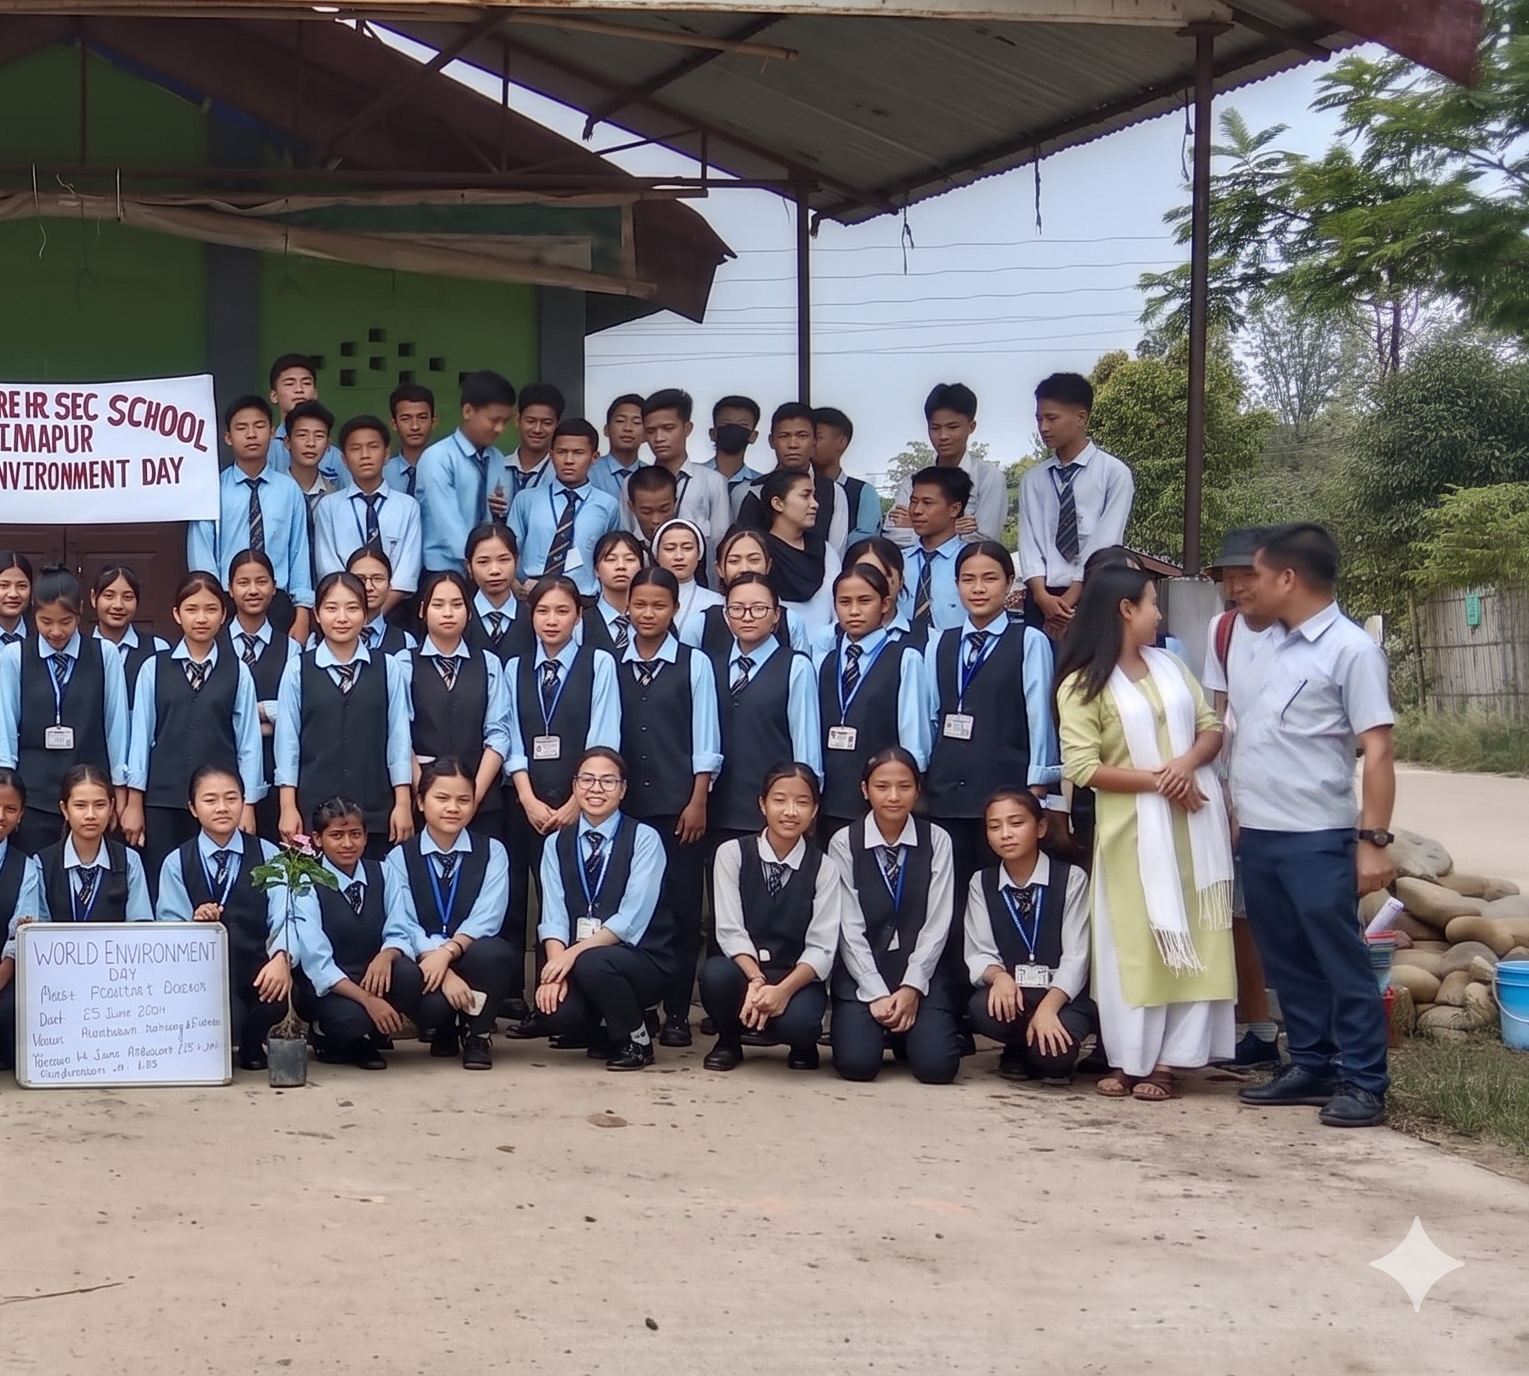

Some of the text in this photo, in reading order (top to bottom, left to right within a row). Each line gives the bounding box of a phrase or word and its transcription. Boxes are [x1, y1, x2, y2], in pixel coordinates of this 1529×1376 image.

[25, 391, 50, 419] HR
[54, 392, 99, 421] SEC
[107, 394, 209, 453] SCHOOL
[141, 456, 184, 486] DAY
[33, 940, 217, 966] WORLD ENVIRONMENT
[109, 968, 137, 982] DAY
